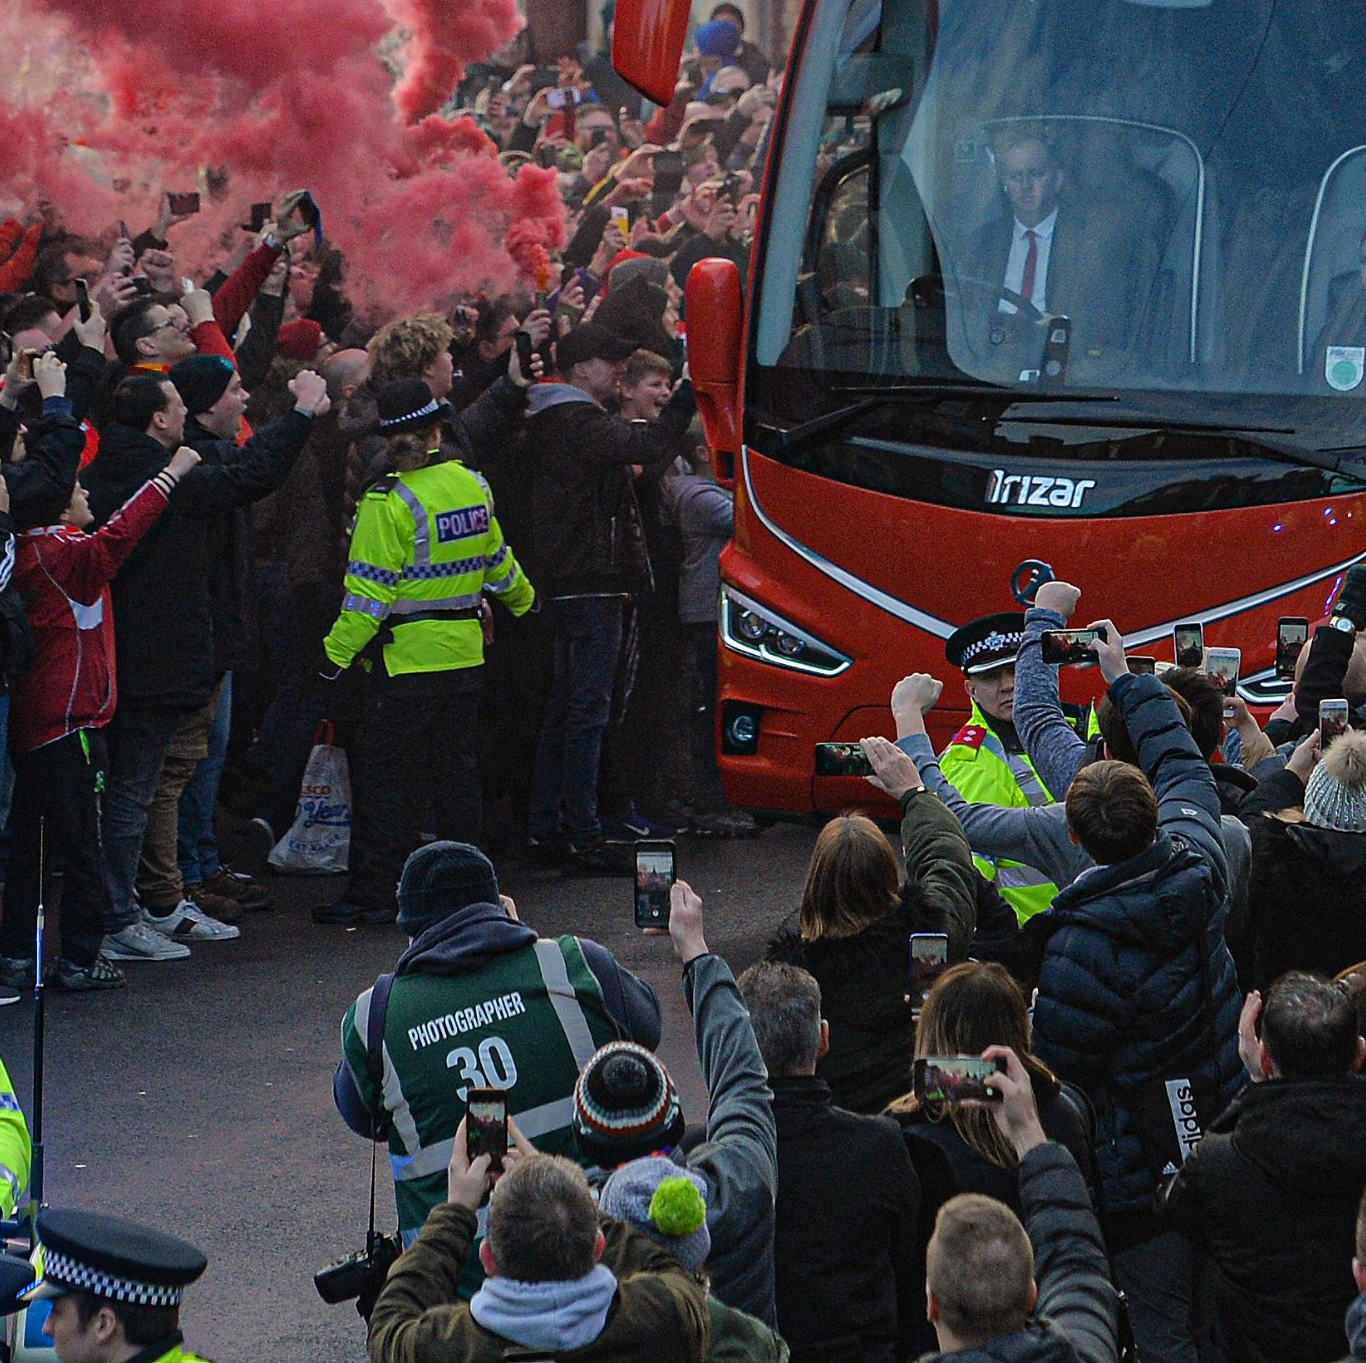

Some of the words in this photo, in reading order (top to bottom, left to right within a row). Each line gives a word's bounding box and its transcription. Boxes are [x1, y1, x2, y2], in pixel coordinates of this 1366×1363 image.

[438, 508, 486, 539] POLICE
[407, 991, 526, 1051] PHOTOGRAPHER
[445, 1035, 518, 1102] 30
[1176, 1085, 1203, 1152] didas
